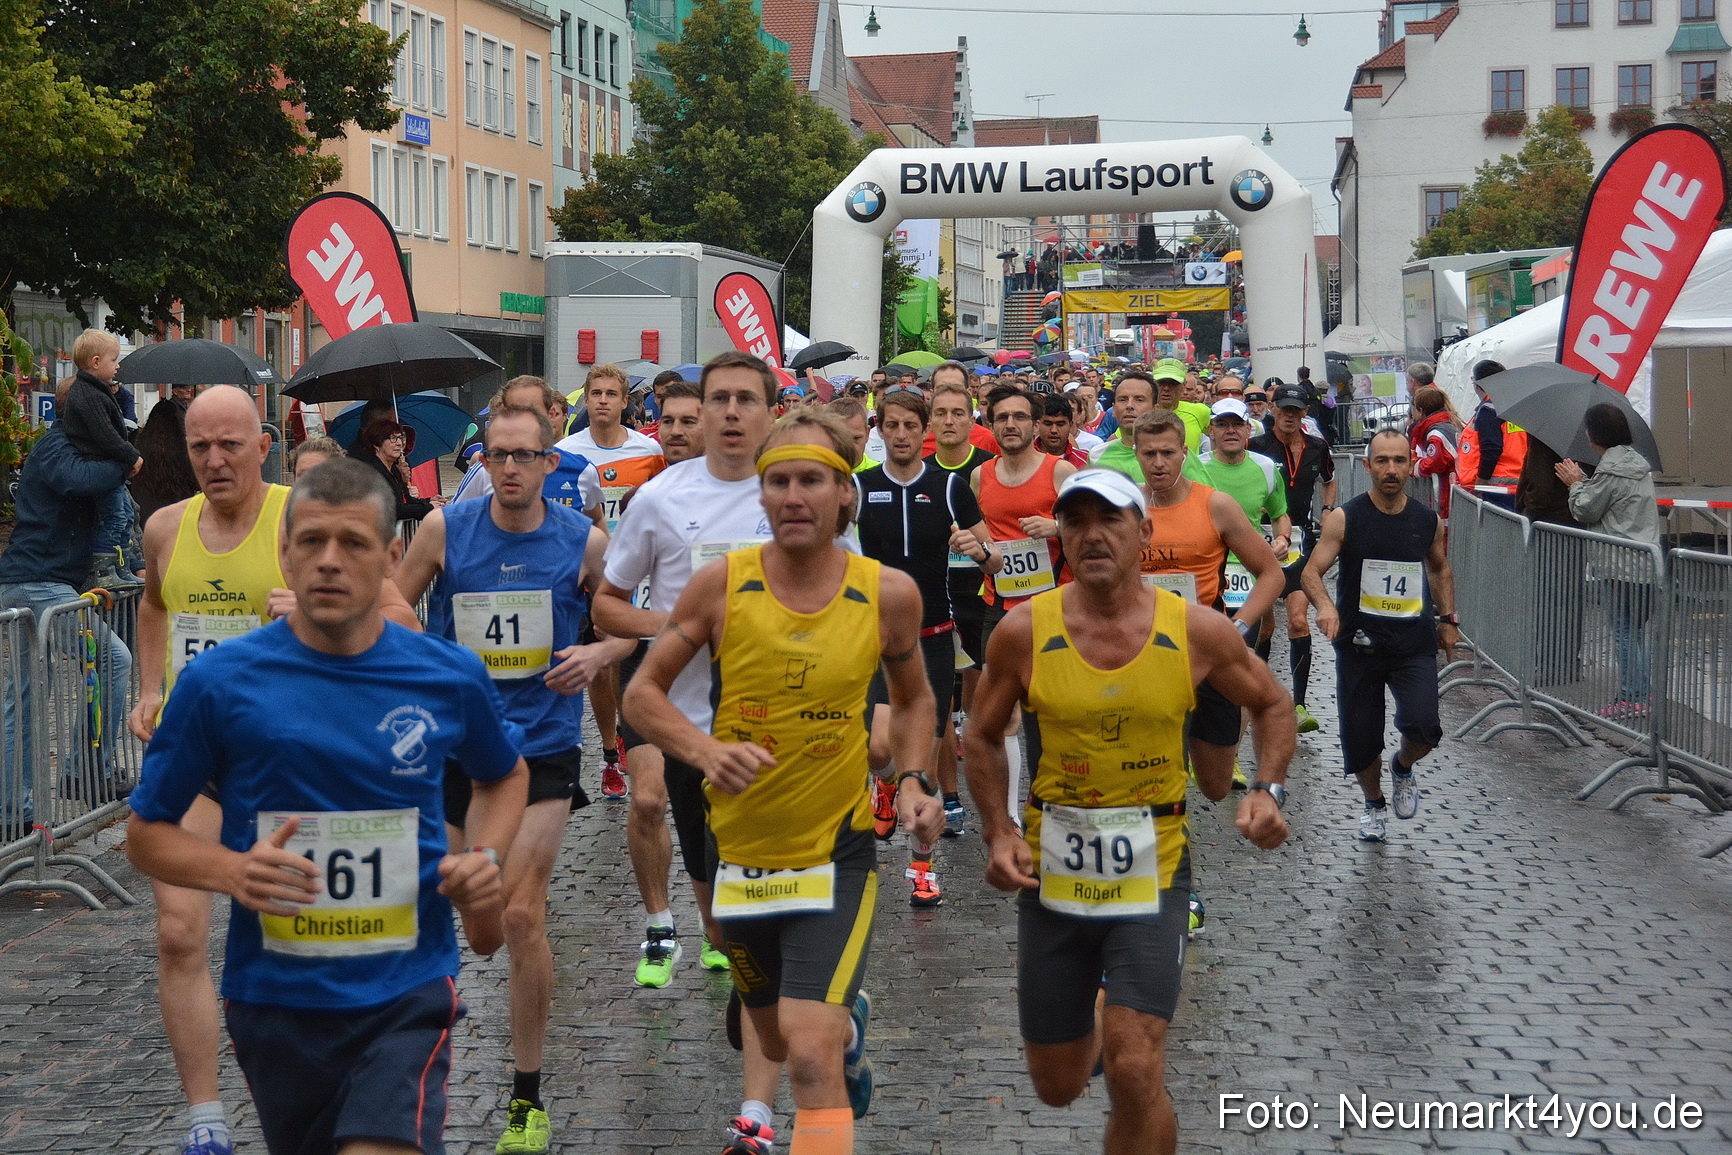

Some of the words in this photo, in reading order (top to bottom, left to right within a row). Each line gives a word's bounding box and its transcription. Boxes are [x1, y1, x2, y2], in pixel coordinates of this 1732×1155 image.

[901, 161, 1008, 194] BMW
[1019, 155, 1214, 196] Laufsport
[1235, 170, 1269, 184] BMW
[848, 182, 882, 198] BMW
[1573, 160, 1702, 380] REWE
[1128, 294, 1165, 308] ZIEL
[42, 400, 53, 417] P
[1002, 551, 1039, 576] 350
[1014, 578, 1031, 589] Karl
[1382, 574, 1407, 596] 14
[188, 592, 247, 603] DIADORA
[496, 594, 543, 606] BOCK
[1381, 600, 1402, 611] Eyup
[205, 618, 251, 632] BOCK
[485, 613, 521, 645] 41
[484, 654, 527, 668] Nathan
[739, 702, 768, 719] Seidl
[1061, 759, 1090, 775] Seidl
[330, 815, 404, 835] BOCK
[1086, 812, 1141, 826] BOCK
[1063, 832, 1134, 875] 319
[745, 880, 799, 899] Helmut
[1074, 882, 1122, 901] Robert
[293, 914, 384, 936] Christian
